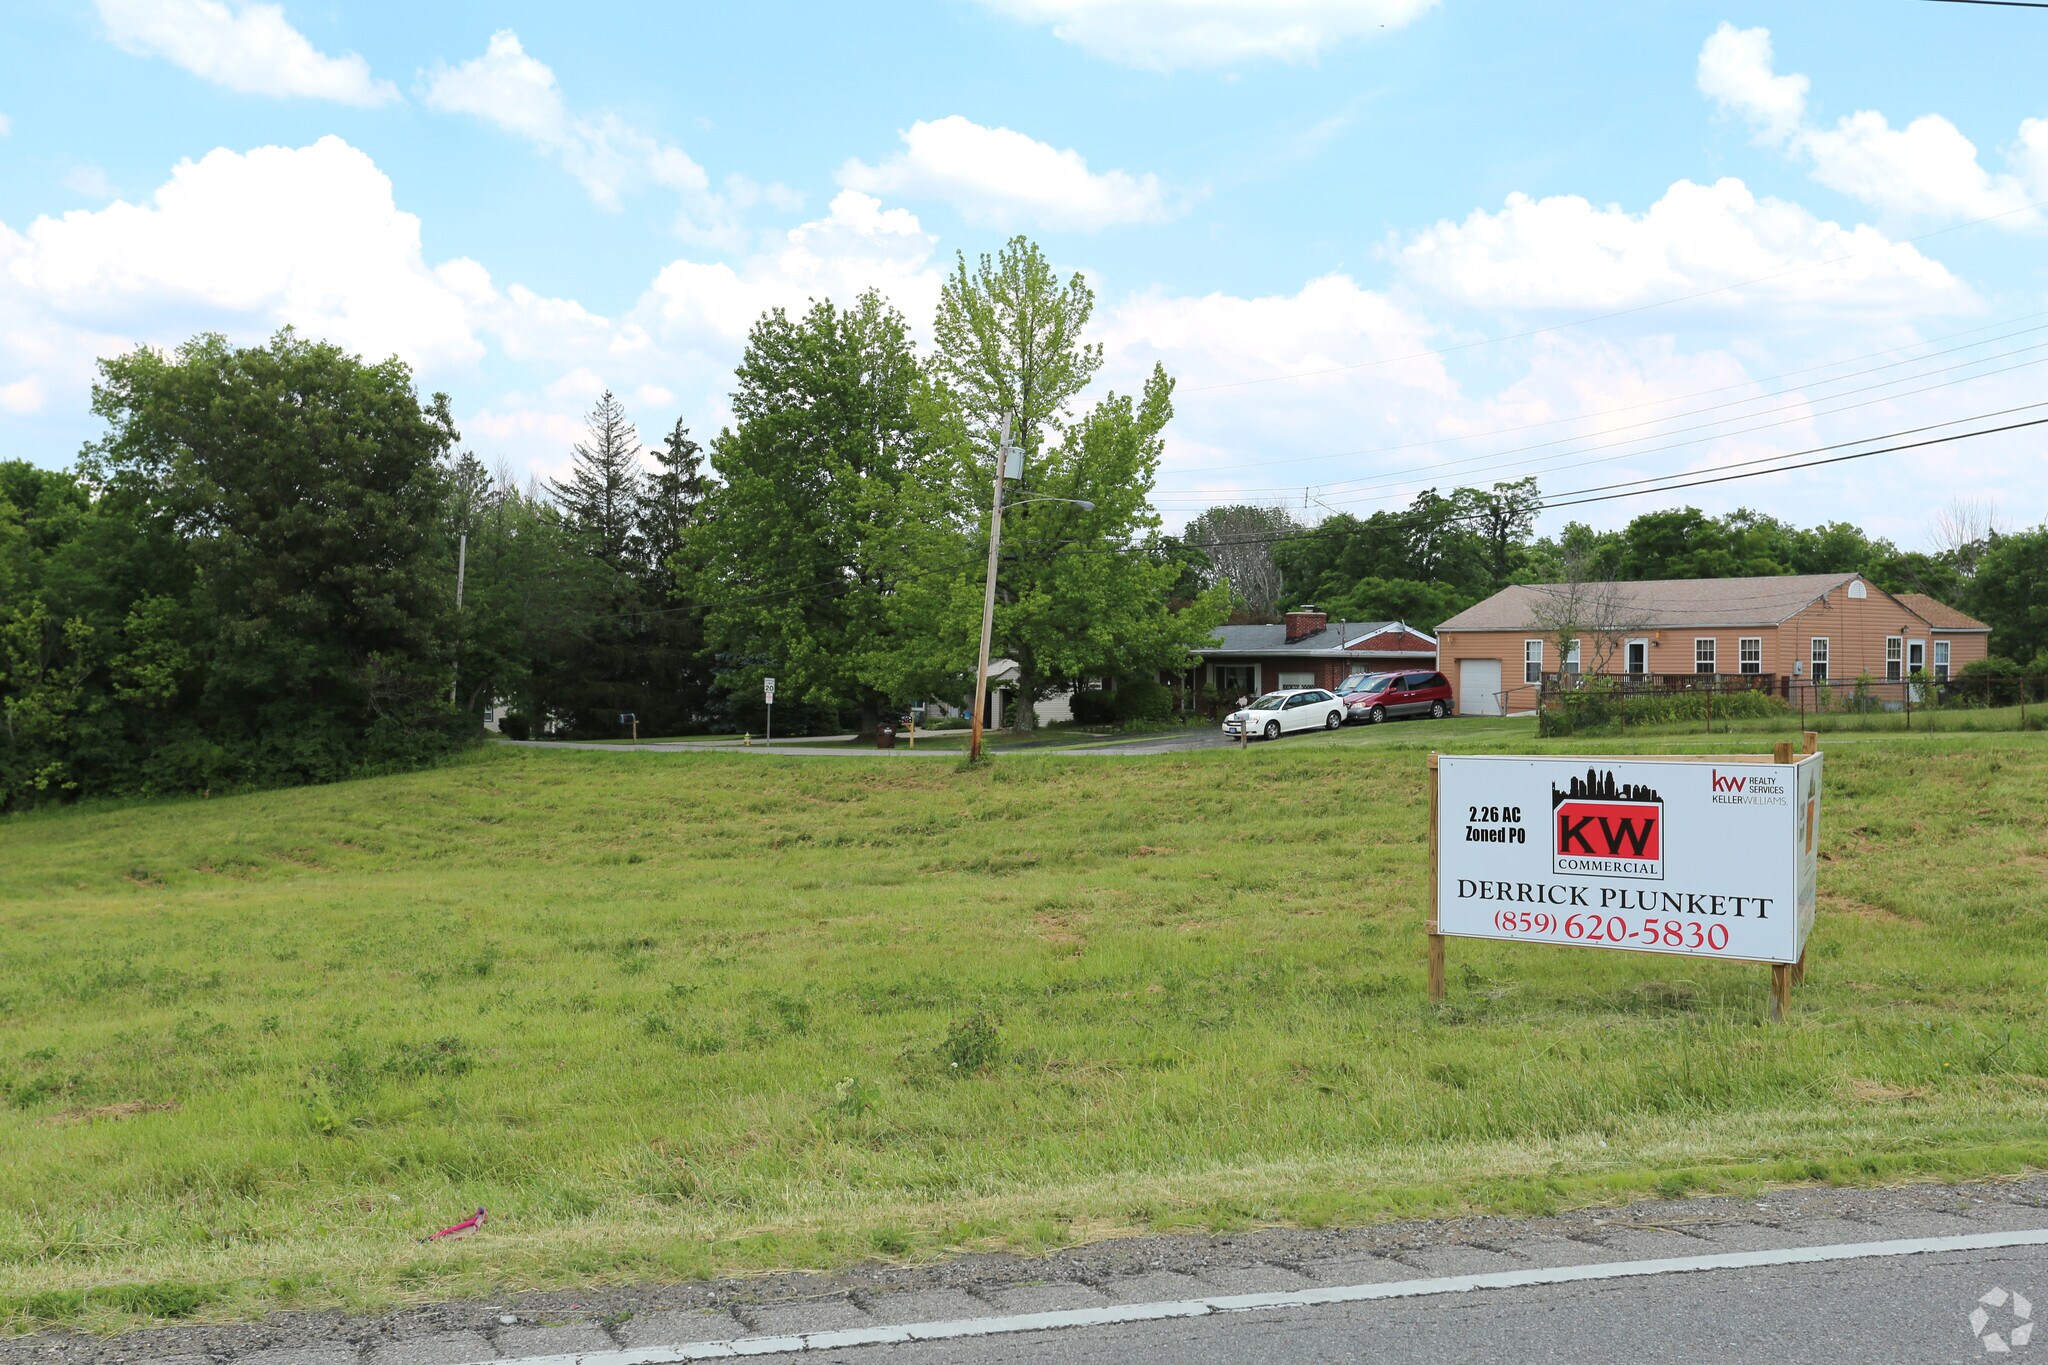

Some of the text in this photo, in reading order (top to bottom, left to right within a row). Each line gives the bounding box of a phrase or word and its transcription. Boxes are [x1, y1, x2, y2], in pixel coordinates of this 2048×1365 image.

[1749, 777, 1776, 785] REALTY
[1749, 786, 1784, 794] SERVICES
[1469, 806, 1521, 823] 2.26 AC
[1465, 826, 1526, 844] Zoned PO
[1560, 815, 1656, 857] KW
[1558, 859, 1658, 875] COMMERCIAL
[1457, 879, 1774, 919] DERRICK PLUNKETT
[1494, 909, 1729, 951] (859) 620-5830
